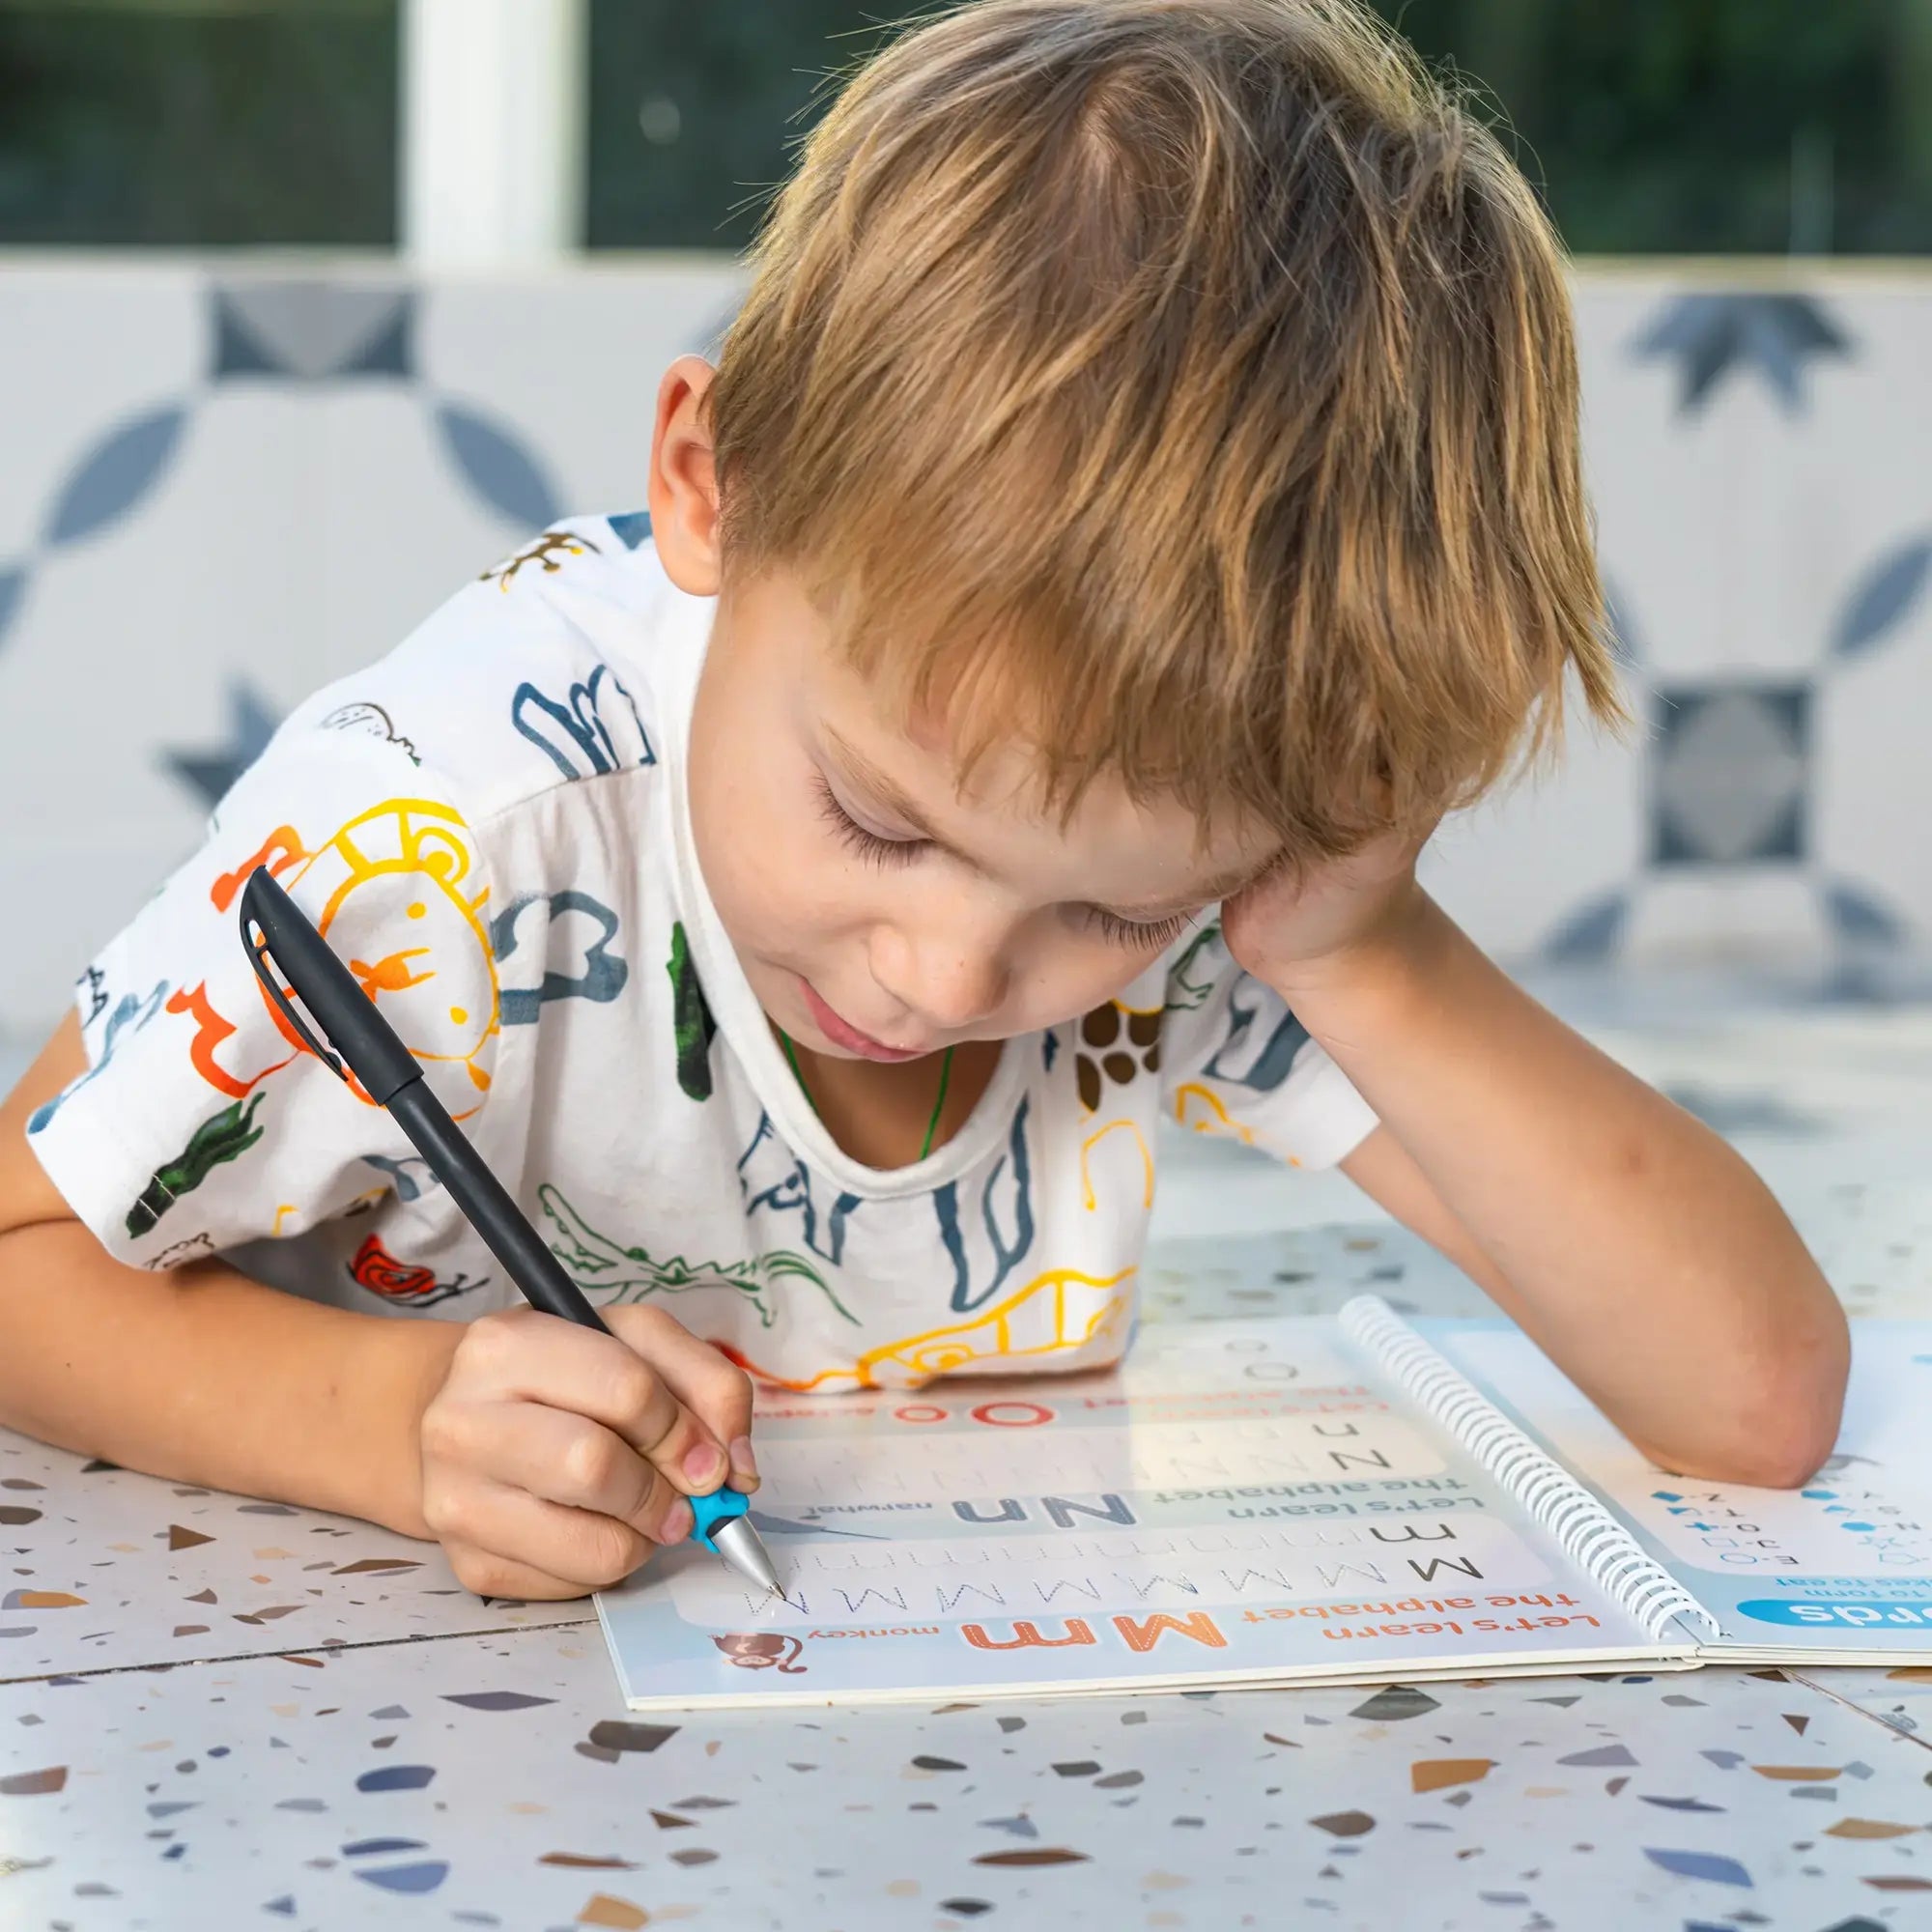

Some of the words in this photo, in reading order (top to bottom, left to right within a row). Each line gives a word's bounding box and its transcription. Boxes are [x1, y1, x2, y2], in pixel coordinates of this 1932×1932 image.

[1311, 1423, 1360, 1438] n
[1327, 1449, 1391, 1471] N
[1153, 1481, 1372, 1505] alphabet
[1378, 1478, 1468, 1492] the
[1227, 1502, 1357, 1521] learn
[1366, 1496, 1485, 1514] Let's
[1368, 1523, 1457, 1544] m
[1406, 1556, 1484, 1582] M
[1776, 1578, 1826, 1587] eat
[833, 1586, 908, 1613] M
[935, 1583, 1007, 1613] M
[1485, 1593, 1580, 1608] the
[1804, 1590, 1881, 1599] form
[1240, 1598, 1476, 1624] alphabet
[1788, 1605, 1932, 1626] rds
[1321, 1621, 1463, 1640] learn
[1472, 1614, 1601, 1632] Let's
[807, 1626, 940, 1640] monkey
